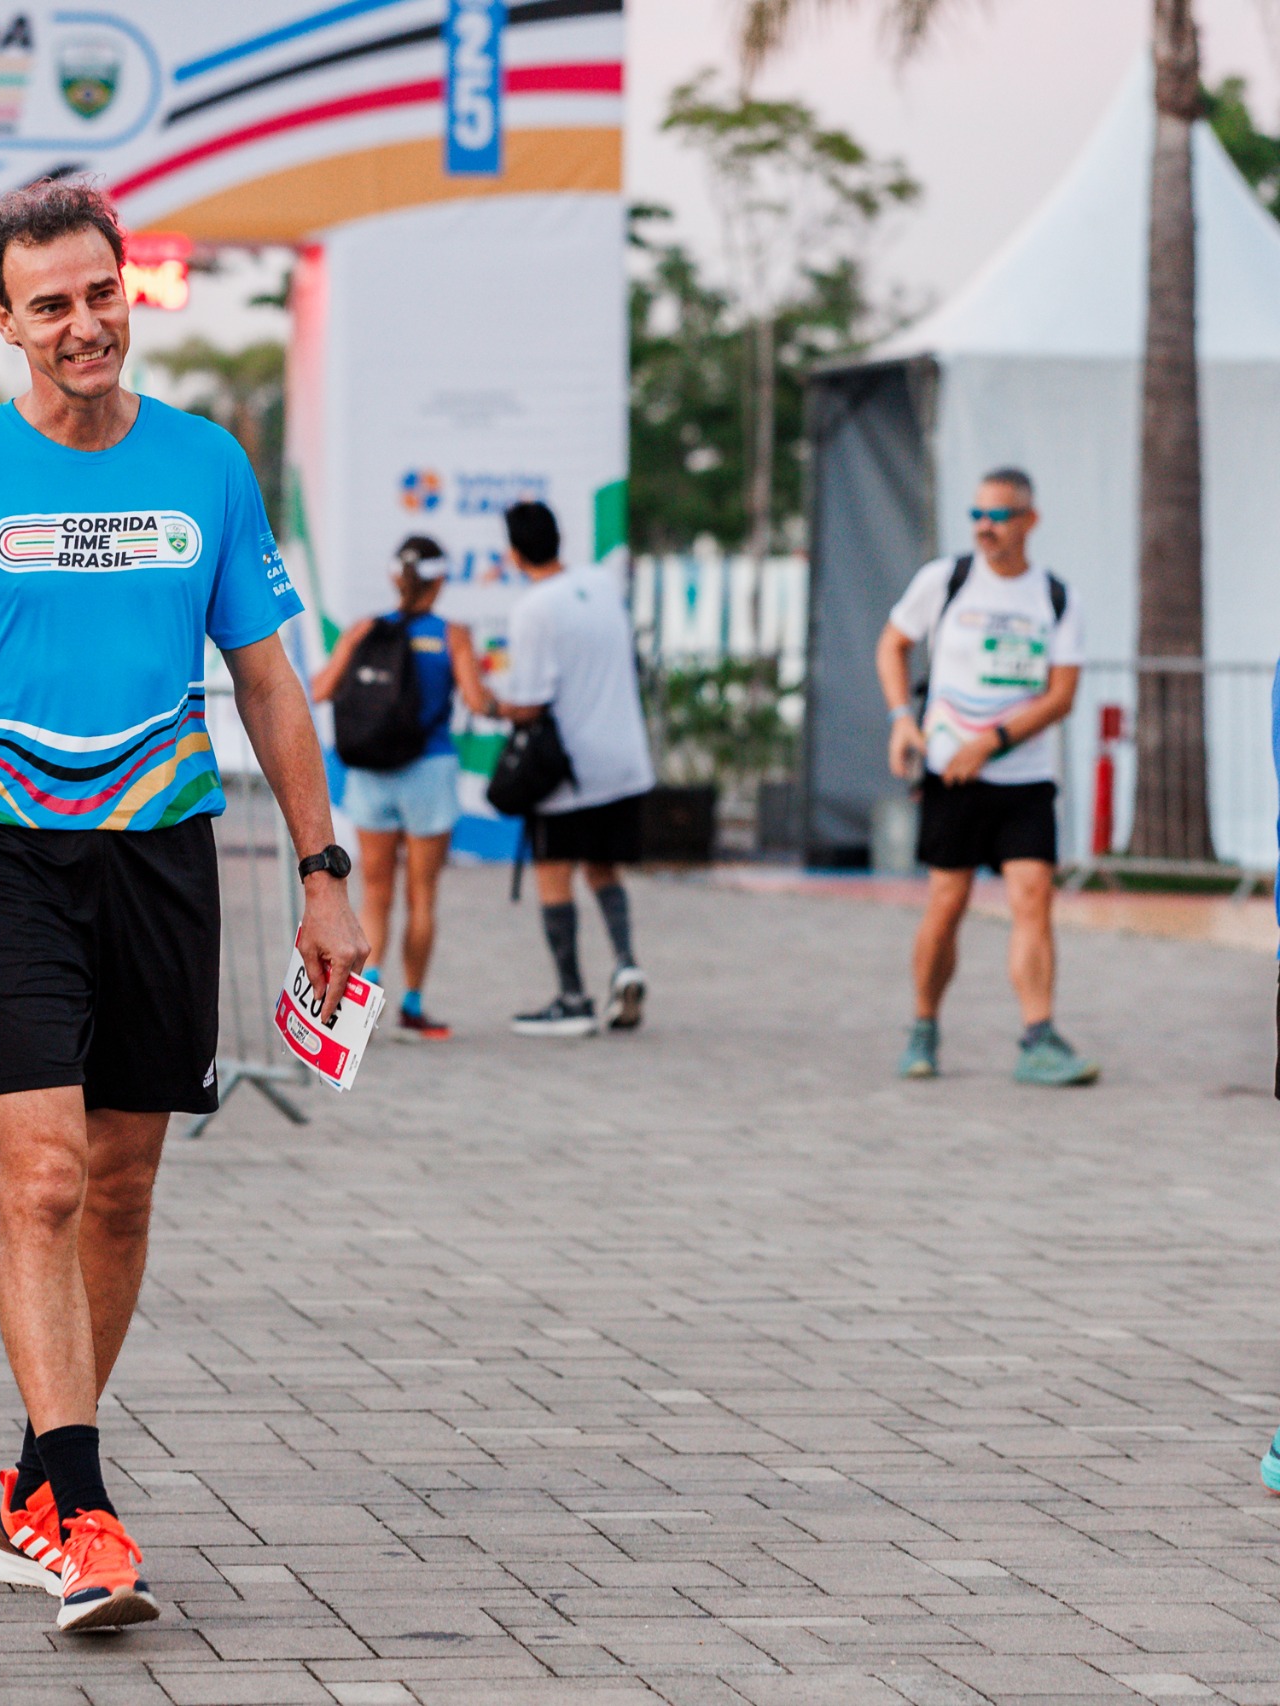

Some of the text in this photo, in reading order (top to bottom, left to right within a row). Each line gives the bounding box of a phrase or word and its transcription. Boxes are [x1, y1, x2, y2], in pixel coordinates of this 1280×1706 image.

[63, 516, 158, 533] CORRIDA
[61, 535, 111, 550] TIME
[58, 552, 132, 567] BRASIL
